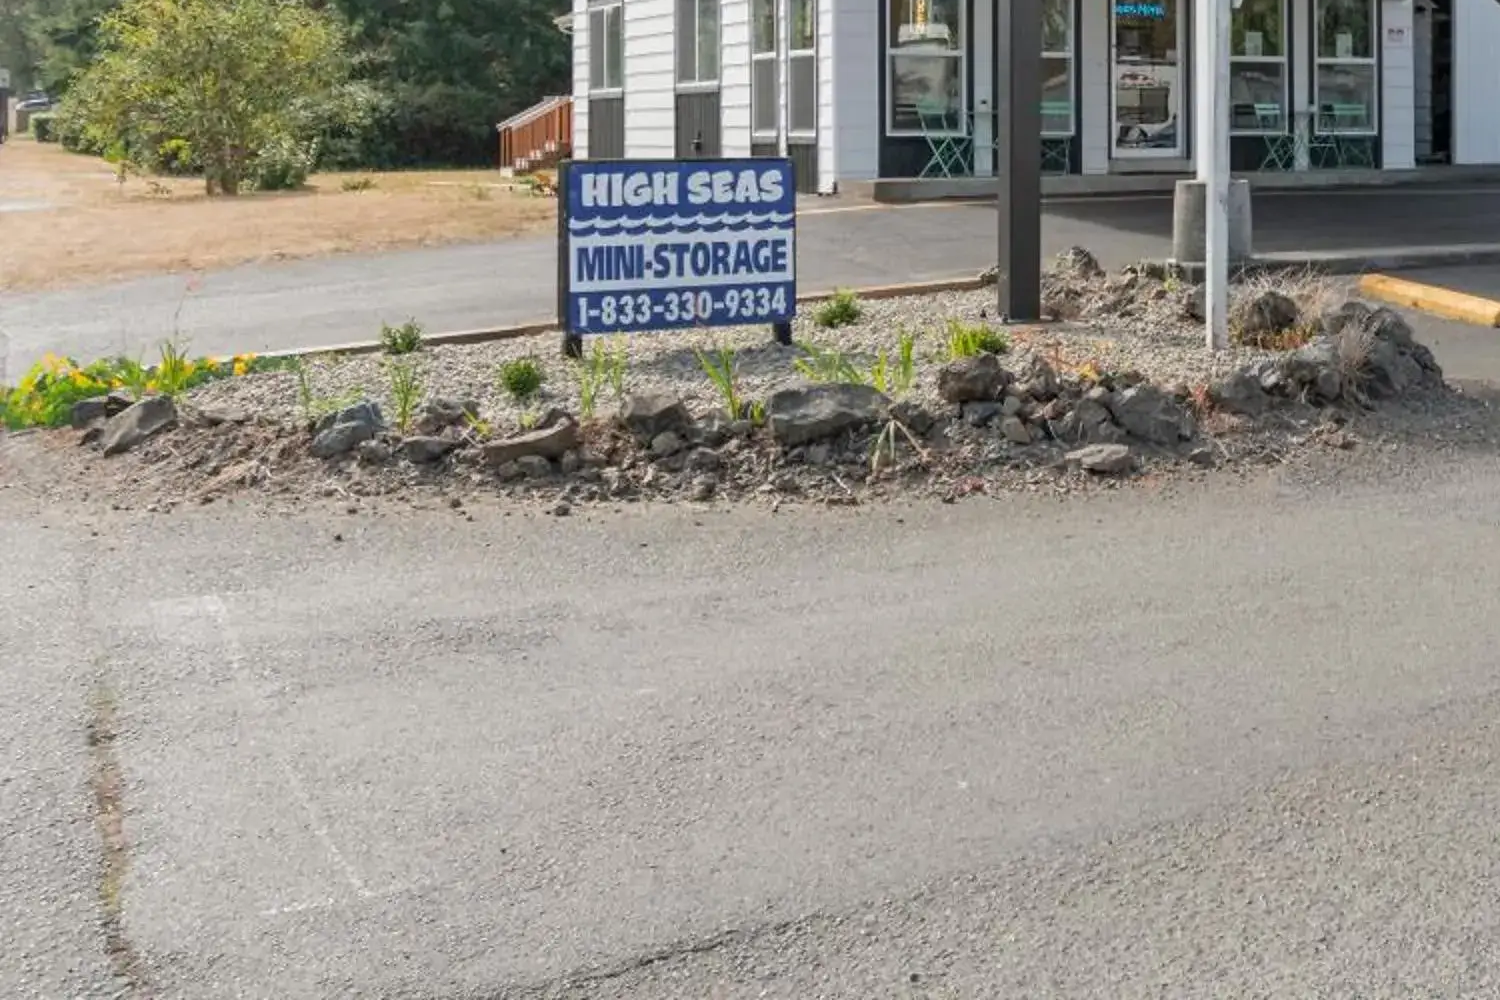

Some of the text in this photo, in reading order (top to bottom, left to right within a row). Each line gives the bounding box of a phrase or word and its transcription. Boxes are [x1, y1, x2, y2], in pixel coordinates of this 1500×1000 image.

[581, 169, 784, 207] HIGH SEAS
[578, 287, 786, 327] 1-833-330-9334
